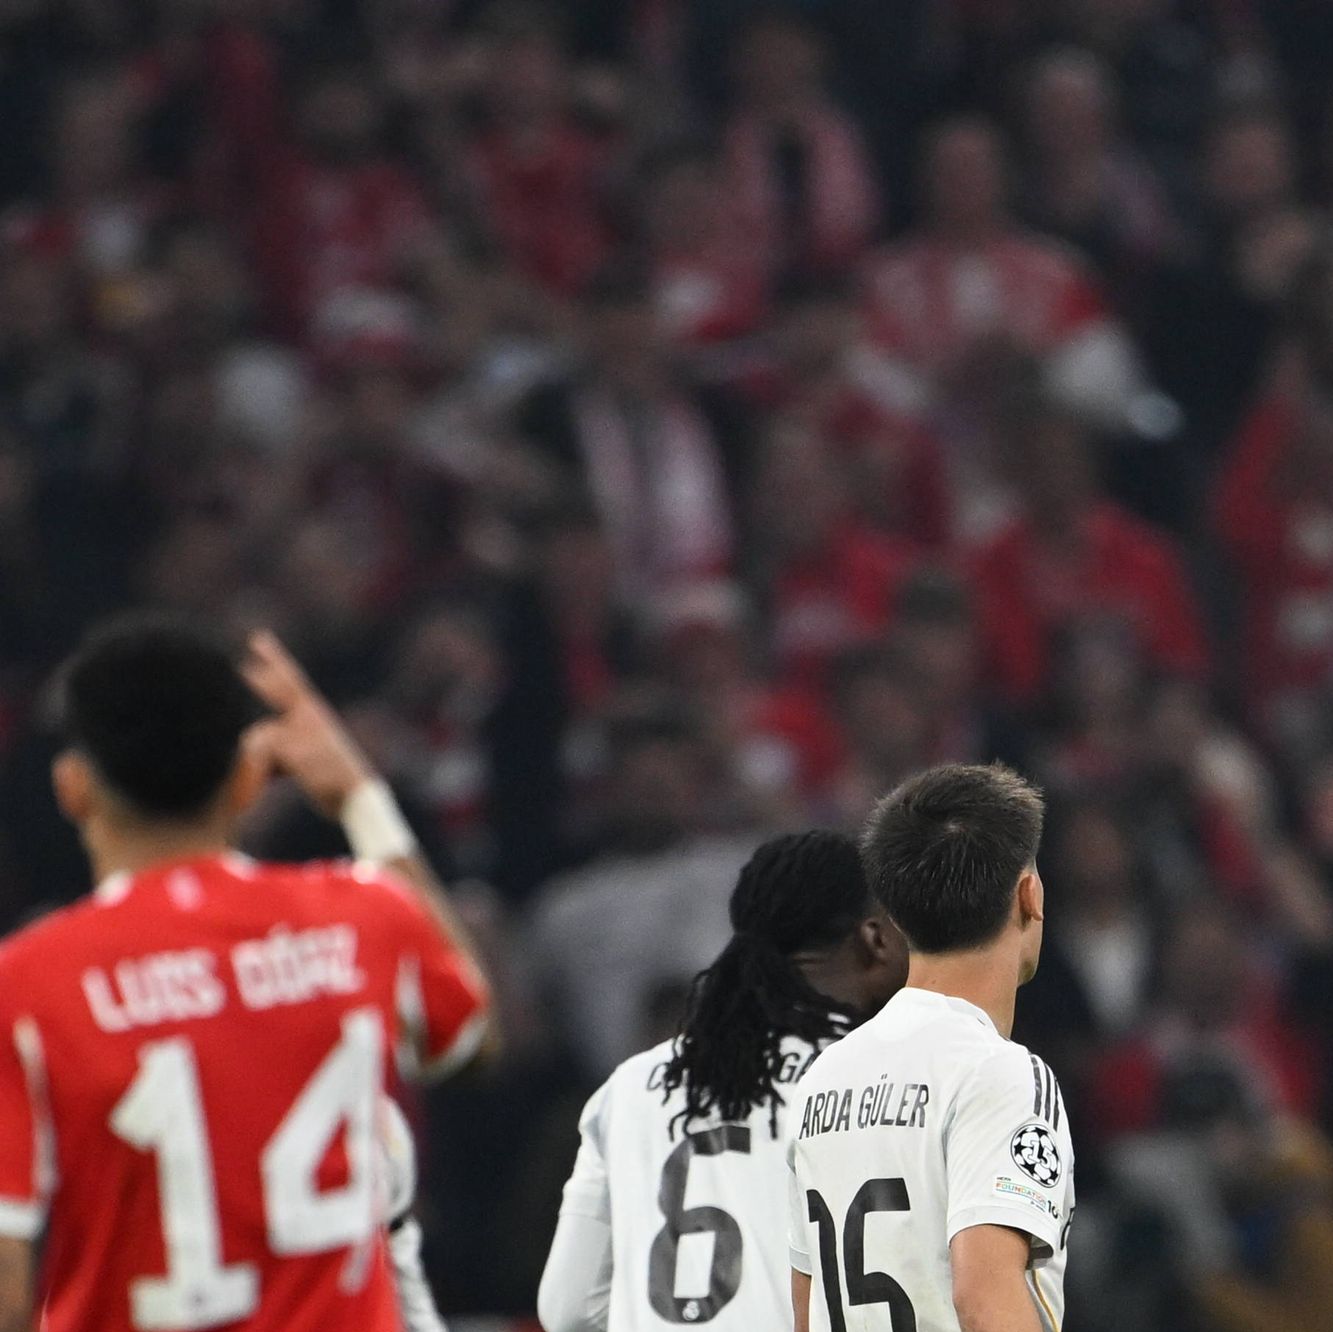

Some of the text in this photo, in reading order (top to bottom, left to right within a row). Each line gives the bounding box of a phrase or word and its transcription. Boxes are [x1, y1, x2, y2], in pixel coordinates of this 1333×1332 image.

[799, 1073, 930, 1140] ARDA GÜLER
[647, 1124, 751, 1325] 6
